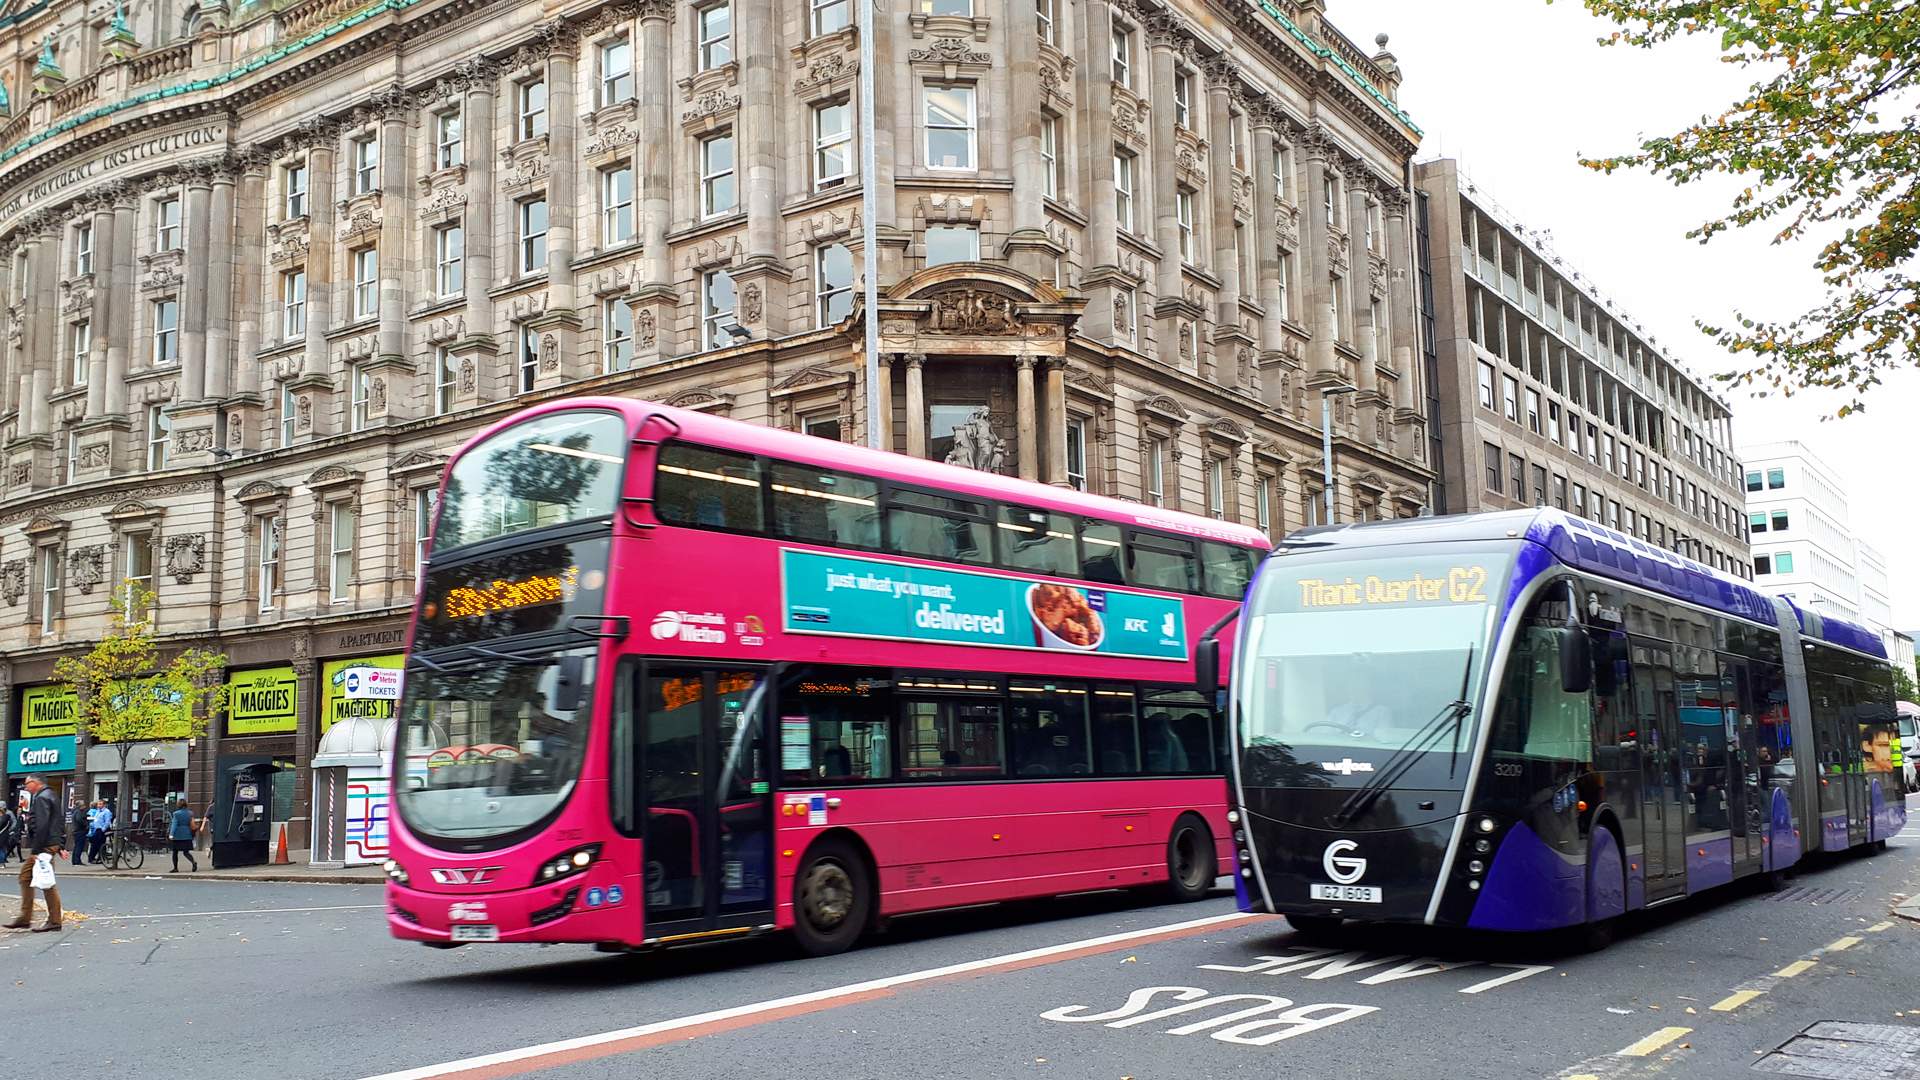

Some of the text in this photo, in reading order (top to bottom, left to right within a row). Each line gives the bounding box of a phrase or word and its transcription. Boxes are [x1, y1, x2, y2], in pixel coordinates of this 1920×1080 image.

[27, 163, 95, 203] PROVIDENT
[103, 126, 216, 170] INSTITUTION
[826, 568, 856, 592] just
[857, 573, 893, 593] what
[893, 580, 919, 599] you
[1296, 566, 1489, 607] Titanic Quarter G2
[915, 601, 1005, 635] delivered
[1124, 617, 1149, 633] KFC
[339, 630, 404, 649] APARTMENT
[679, 623, 727, 644] Metro
[379, 676, 397, 684] Metro
[240, 688, 289, 713] MAGGIES
[368, 686, 396, 696] TICKETS
[33, 700, 74, 722] MAGGIES
[336, 700, 378, 719] MAGGIES
[19, 747, 59, 766] Centra
[1494, 763, 1523, 777] 3209
[1319, 886, 1341, 899] IGZ
[1196, 946, 1555, 994] LANE
[1039, 986, 1382, 1046] BUS
